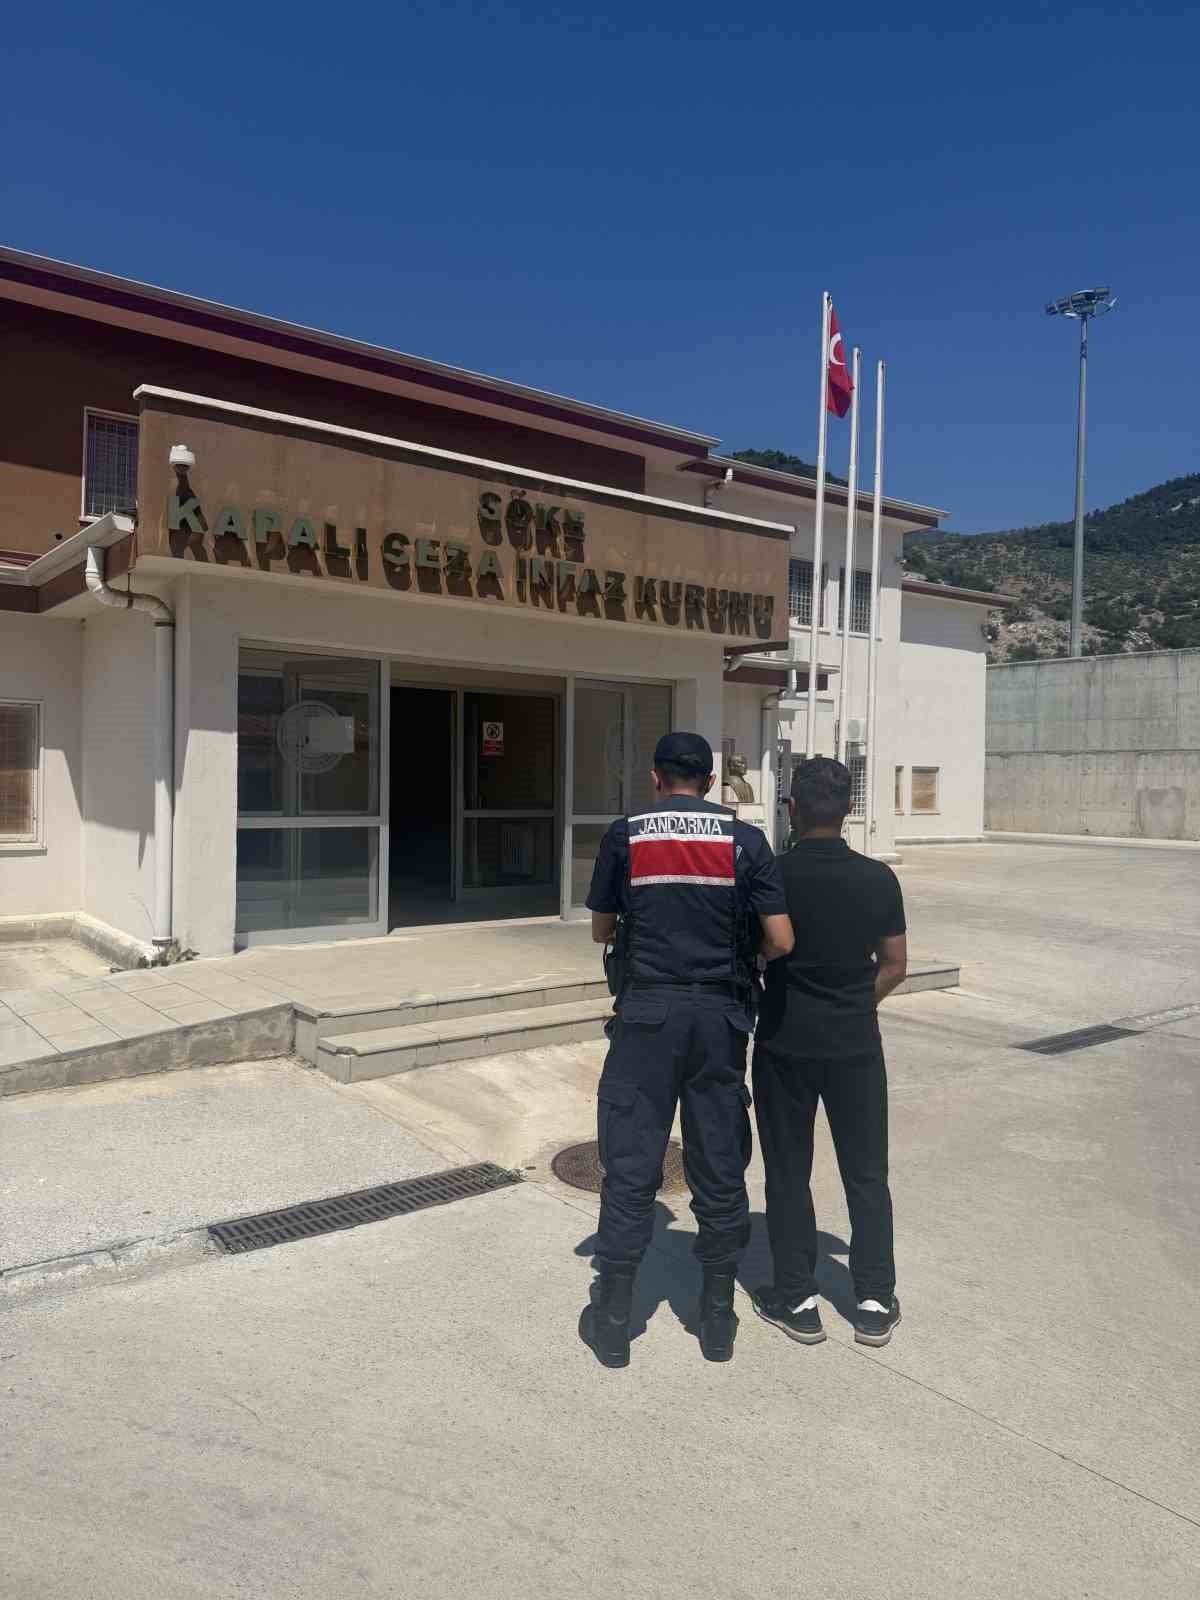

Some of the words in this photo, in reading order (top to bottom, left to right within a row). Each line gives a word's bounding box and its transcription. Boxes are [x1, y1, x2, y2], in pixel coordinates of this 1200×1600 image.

[479, 490, 585, 543] SÖKE
[168, 495, 367, 556] KAPALI
[382, 532, 504, 581] CEZA
[634, 576, 774, 622] KURUMU
[639, 816, 722, 836] JANDARMA
